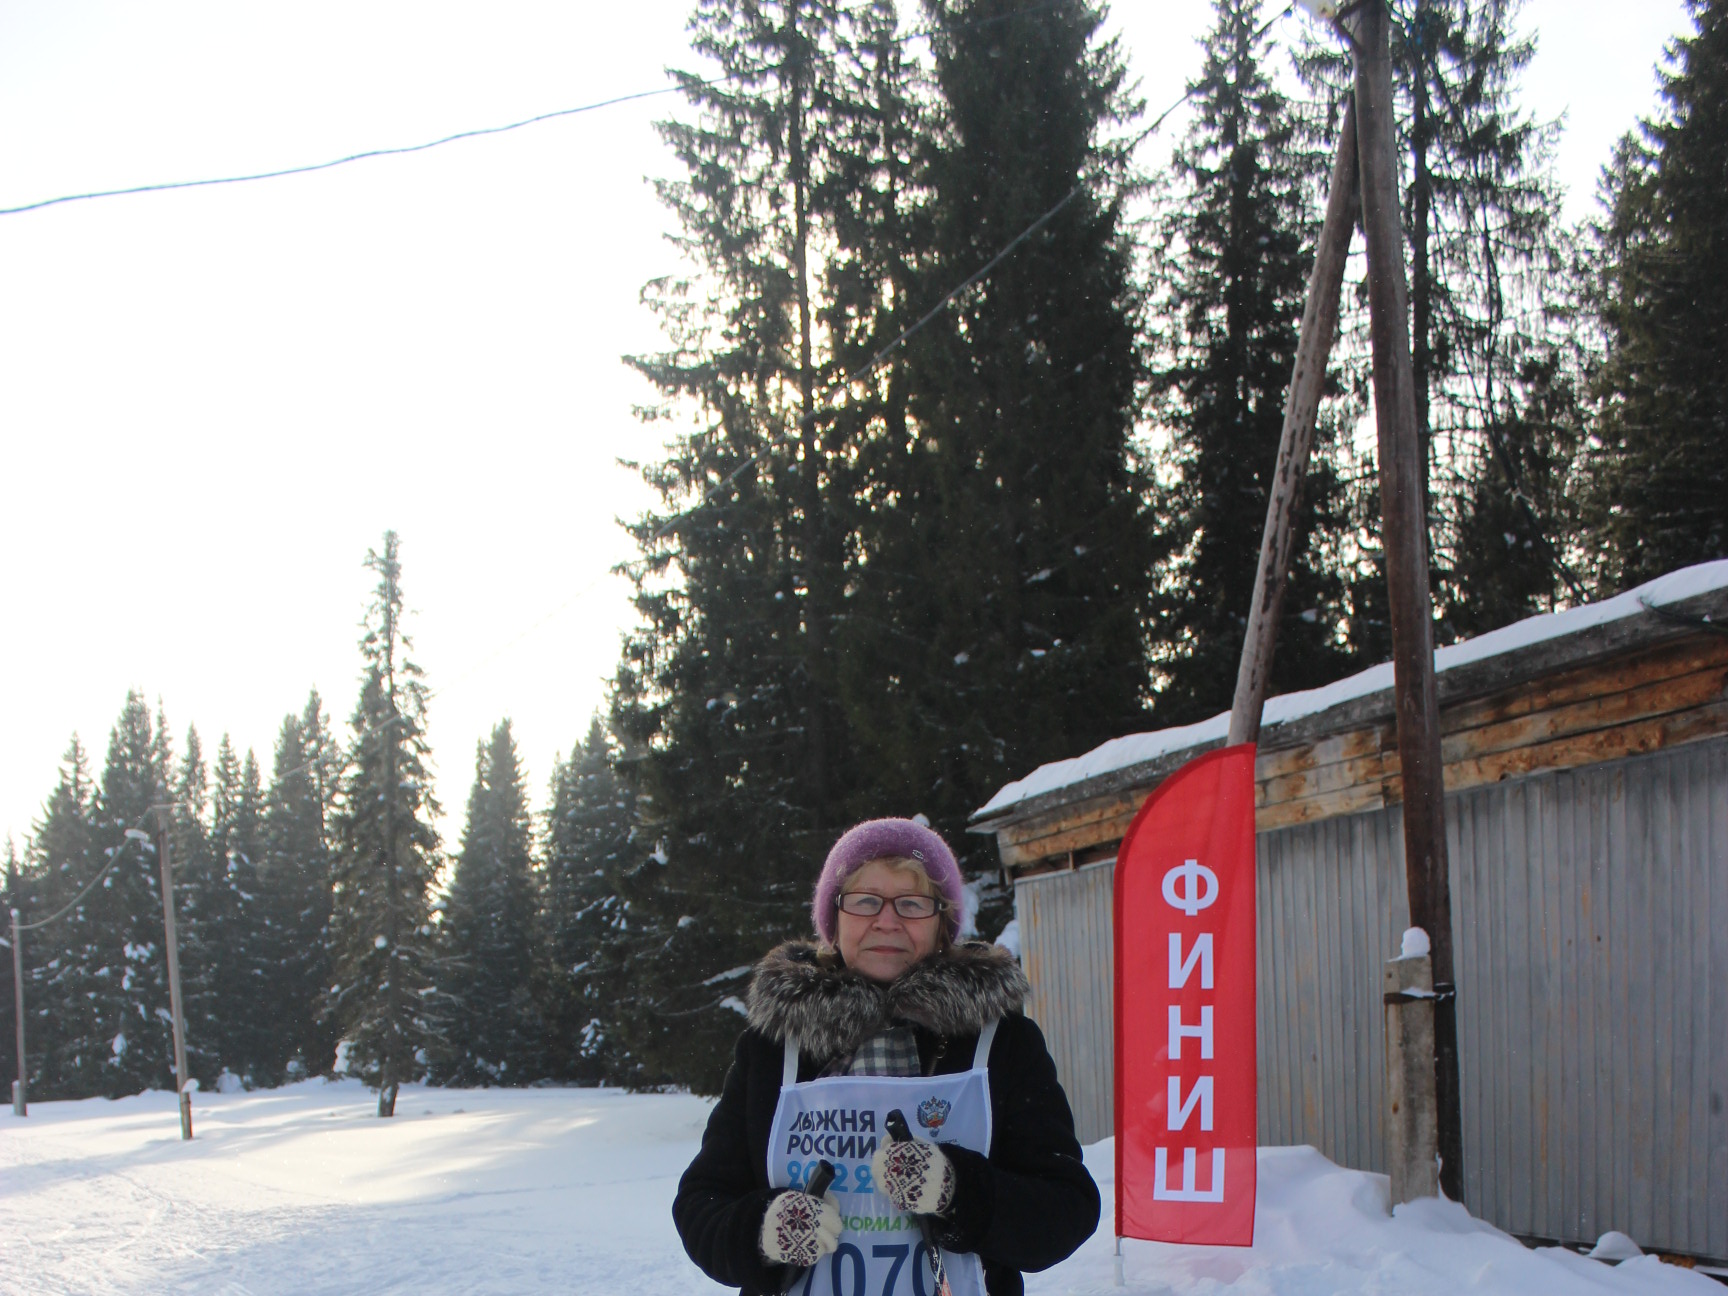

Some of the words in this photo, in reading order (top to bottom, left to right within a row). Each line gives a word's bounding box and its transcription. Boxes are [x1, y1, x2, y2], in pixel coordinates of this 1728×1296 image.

[1153, 858, 1226, 1203] ФИНИШ
[788, 1109, 876, 1132] ЛЫЖНЯ
[786, 1133, 877, 1159] РОССИИ
